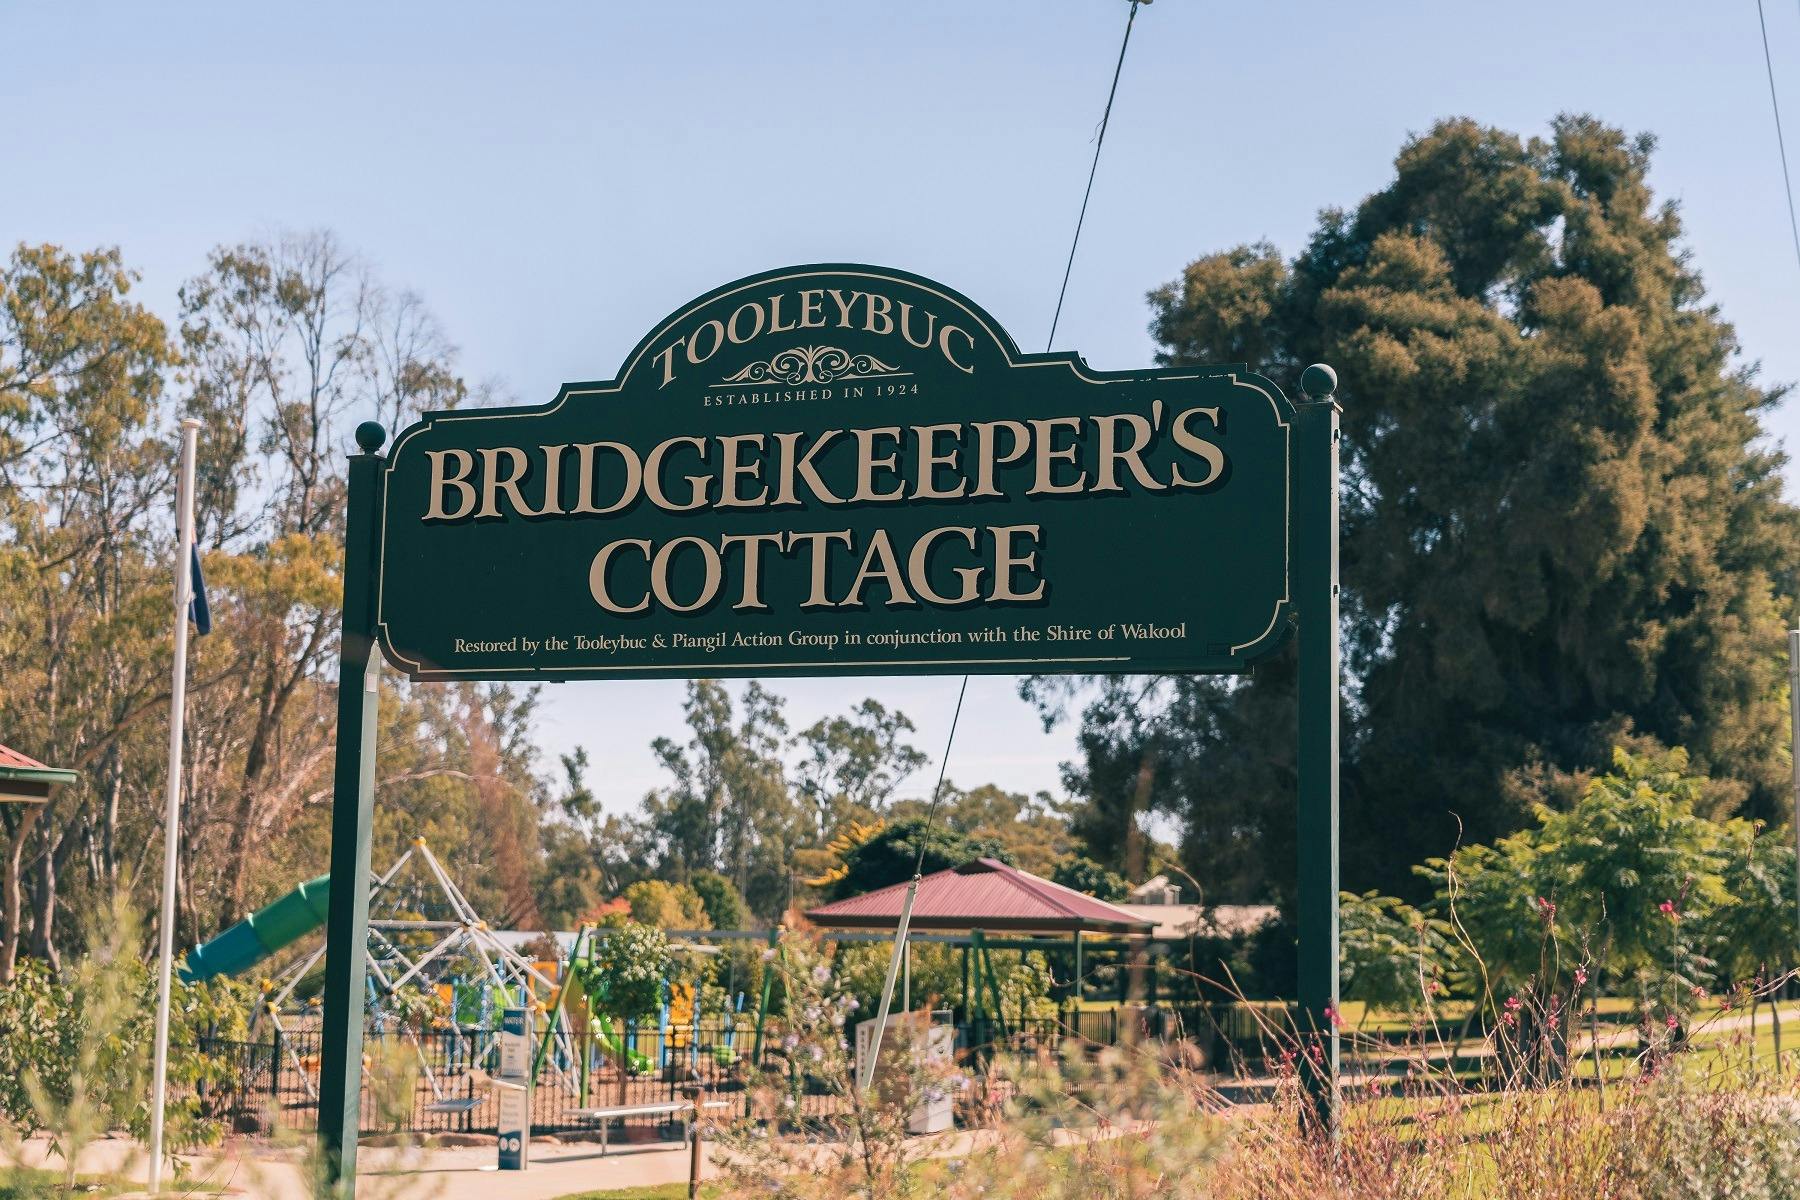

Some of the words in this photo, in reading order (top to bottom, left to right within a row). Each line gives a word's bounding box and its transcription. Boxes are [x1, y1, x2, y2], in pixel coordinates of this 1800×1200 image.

[652, 288, 975, 390] TOOLEYBUC
[703, 389, 833, 407] ESTABLISHED
[844, 386, 864, 398] IN
[876, 383, 919, 397] 1924
[421, 399, 1225, 521] BRIDGEKEEPER'S
[588, 524, 1046, 613] COTTAGE
[454, 637, 518, 653] Restored
[522, 636, 541, 655] by
[545, 635, 569, 651] the
[574, 634, 647, 655] Tooleybuc
[652, 633, 668, 649] &
[672, 631, 727, 653] Piangil
[731, 630, 784, 647] Action
[788, 630, 839, 651] Group
[844, 629, 862, 645] in
[866, 628, 962, 650] conjunction
[967, 626, 1007, 643] with
[1013, 626, 1041, 642] the
[1046, 624, 1092, 641] Shire
[1097, 623, 1116, 640] of
[1121, 622, 1187, 640] Wakool
